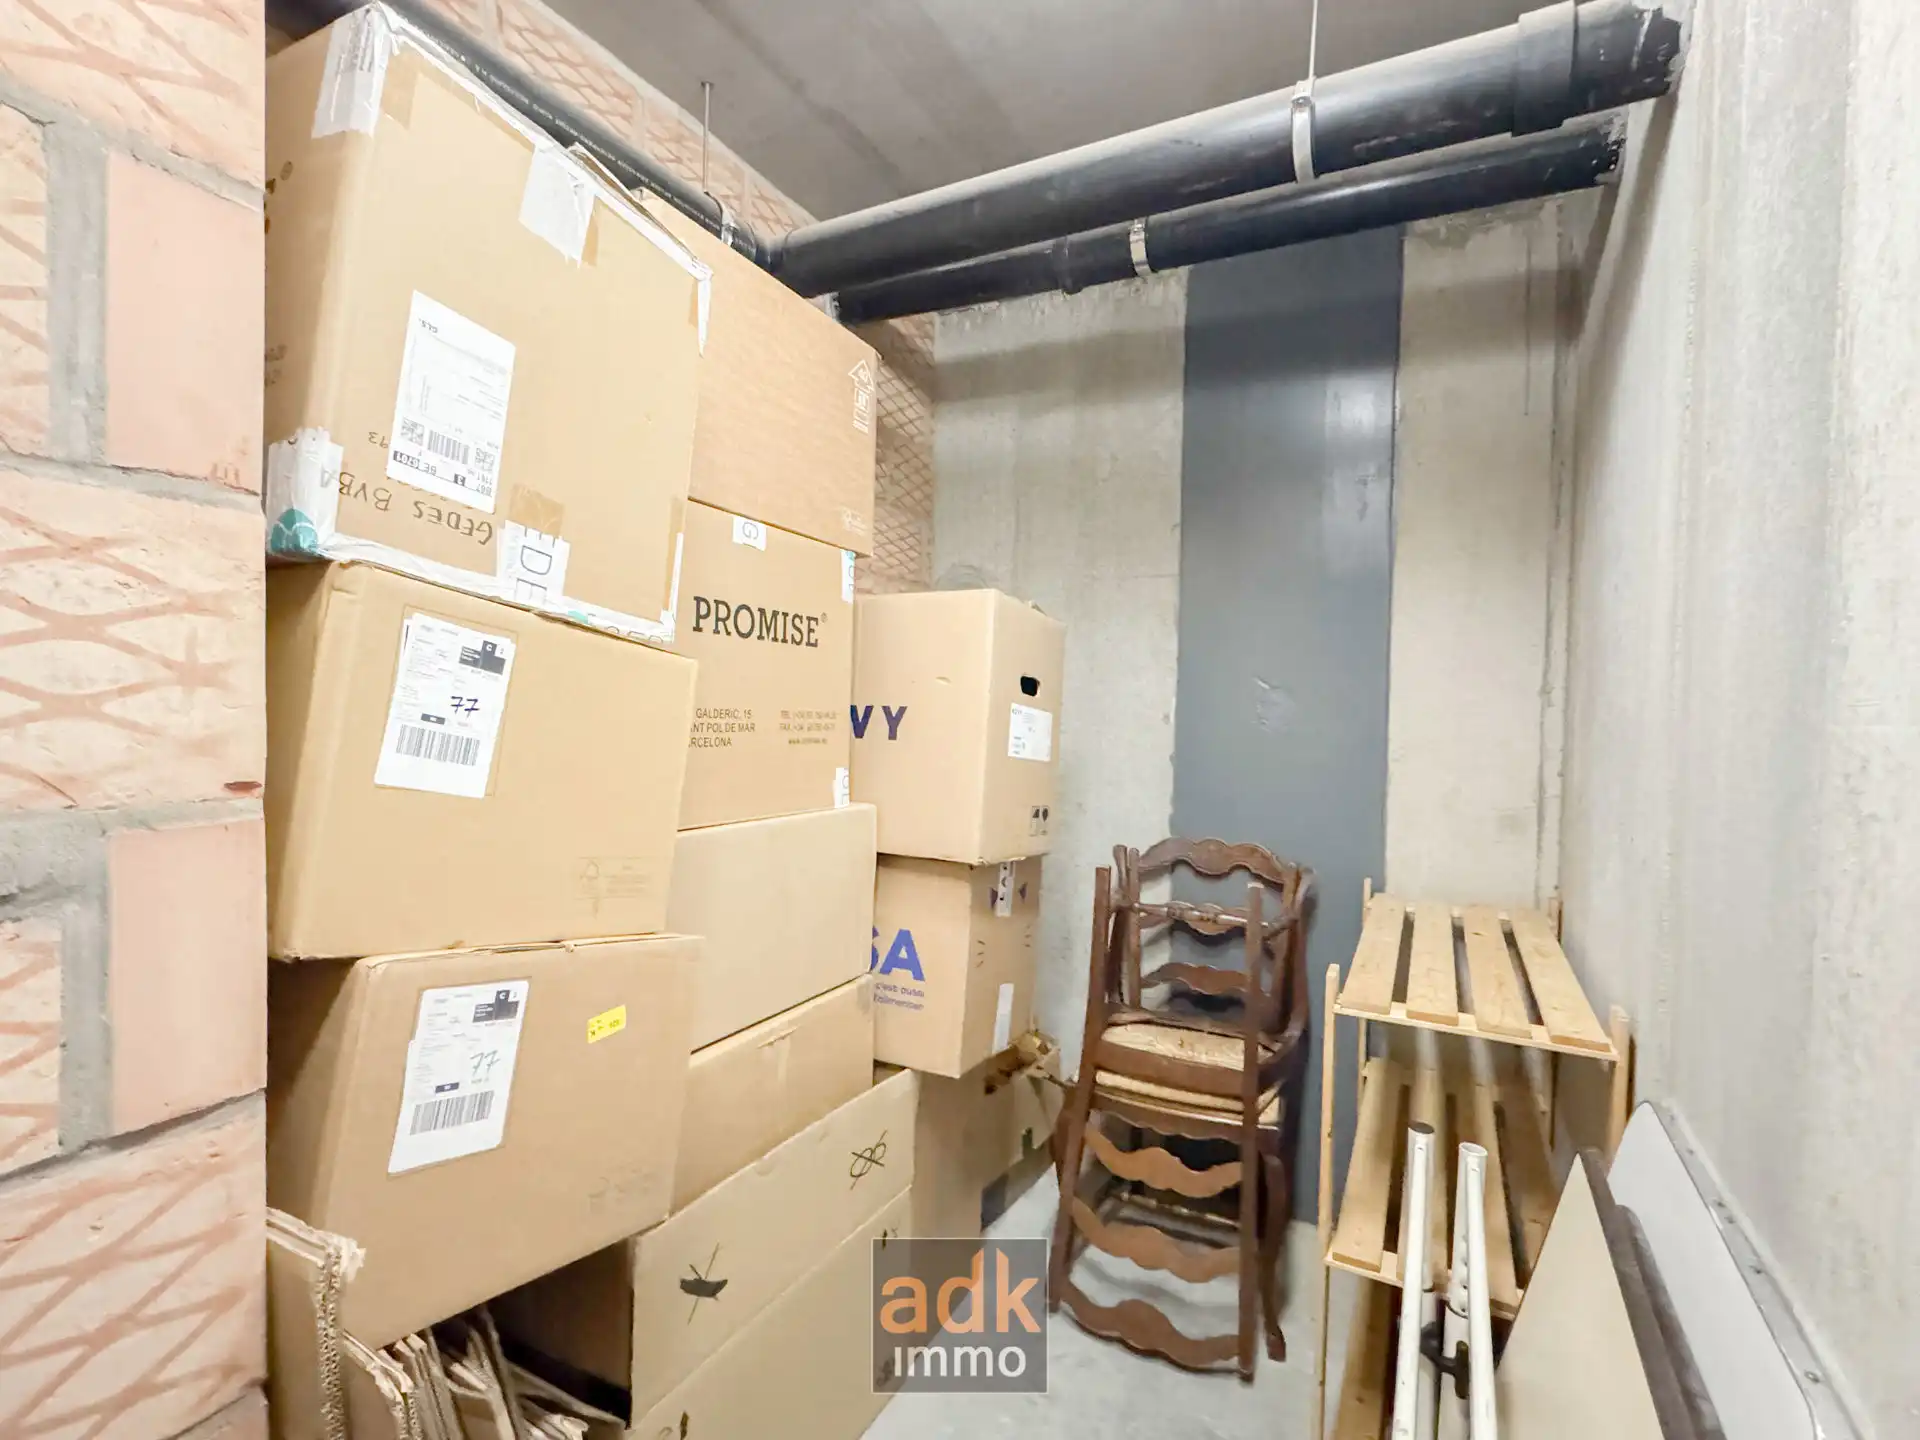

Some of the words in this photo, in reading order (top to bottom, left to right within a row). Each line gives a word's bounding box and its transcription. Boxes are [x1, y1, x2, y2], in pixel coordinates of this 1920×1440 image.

[413, 500, 493, 545] GEDES
[451, 695, 480, 717] 77
[743, 709, 752, 720] 15
[706, 722, 722, 733] POL
[724, 723, 737, 733] DE
[738, 722, 755, 733] MAR
[470, 1050, 500, 1076] 77
